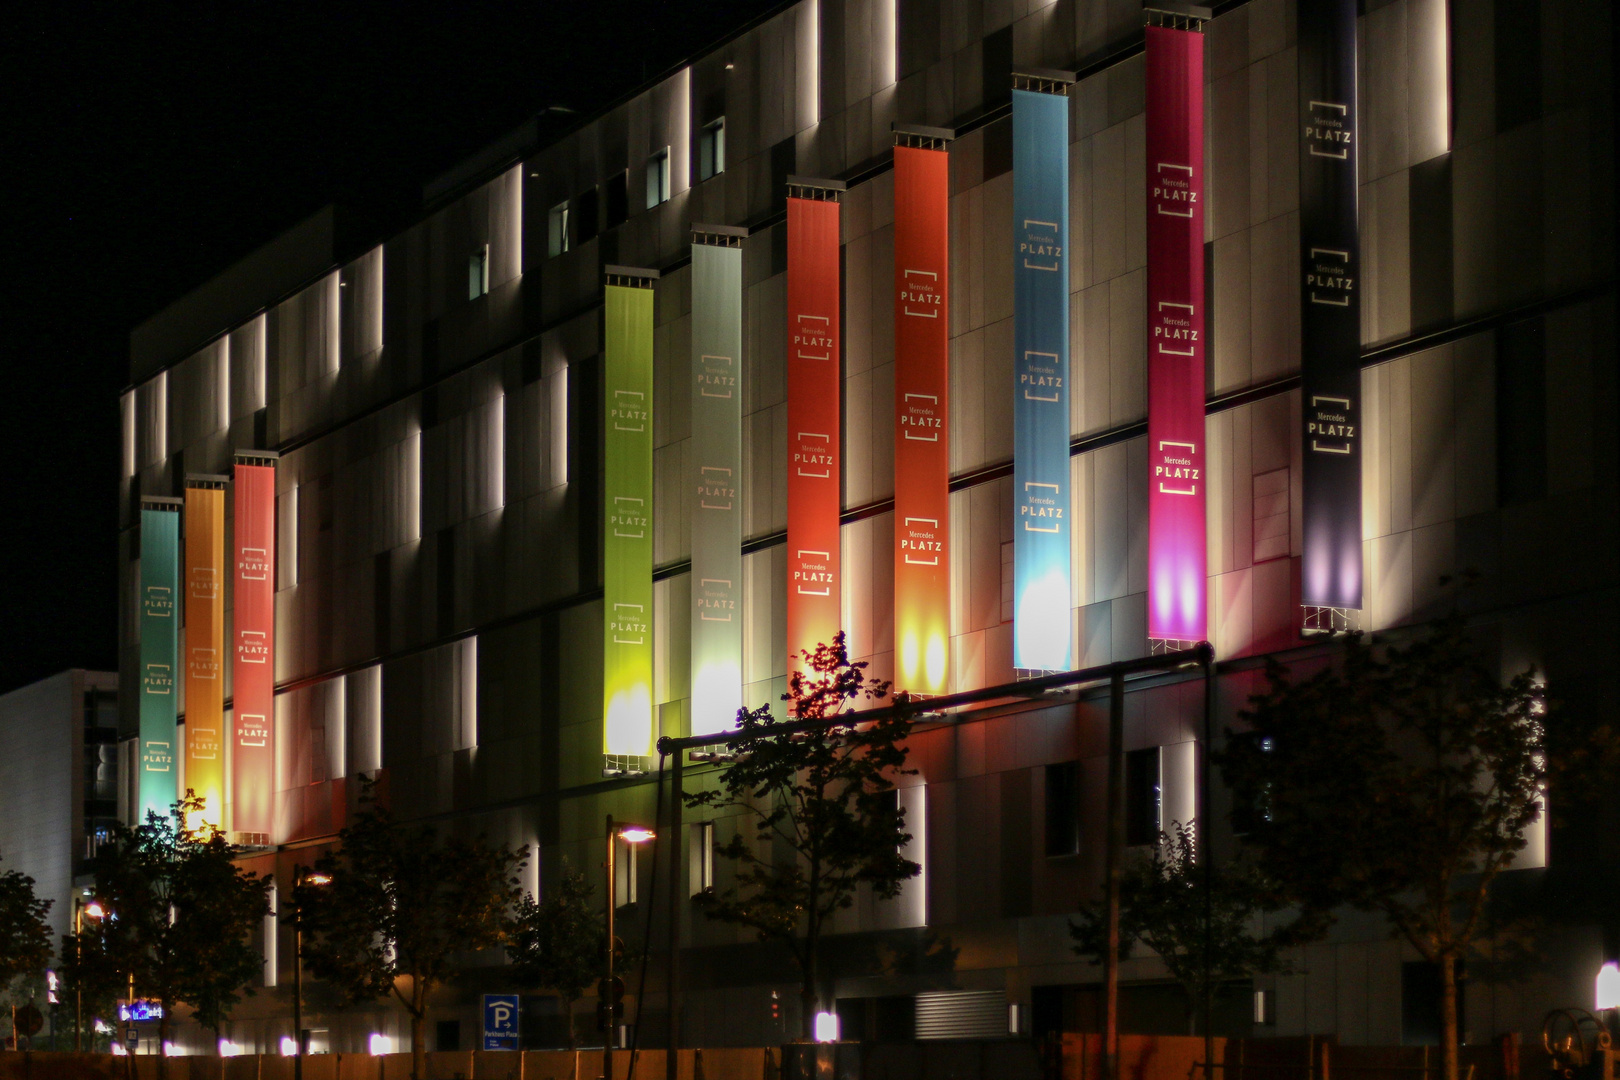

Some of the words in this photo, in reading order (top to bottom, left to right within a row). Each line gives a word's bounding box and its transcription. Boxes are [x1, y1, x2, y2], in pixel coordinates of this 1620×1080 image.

[1314, 116, 1342, 128] Mercedes
[1306, 127, 1351, 143] PLATZ
[1162, 177, 1189, 188] Mercedes
[1154, 187, 1197, 203] PLATZ
[1020, 243, 1061, 257] PLATZ
[1316, 264, 1344, 275] Mercedes
[908, 282, 934, 292] Mercedes
[1307, 274, 1352, 290] PLATZ
[901, 291, 941, 304] PLATZ
[1163, 316, 1190, 327] Mercedes
[801, 326, 826, 336] Mercedes
[1155, 326, 1198, 341] PLATZ
[794, 336, 833, 348] PLATZ
[1028, 365, 1055, 374] Mercedes
[698, 375, 735, 386] PLATZ
[1020, 374, 1062, 388] PLATZ
[611, 409, 647, 420] PLATZ
[909, 406, 934, 415] Mercedes
[901, 415, 941, 428] PLATZ
[1317, 412, 1346, 423] Mercedes
[1309, 422, 1354, 438] PLATZ
[801, 444, 826, 453] Mercedes
[794, 453, 833, 465] PLATZ
[1164, 456, 1191, 466] Mercedes
[1155, 466, 1199, 480] PLATZ
[697, 486, 735, 498] PLATZ
[1029, 496, 1055, 505] Mercedes
[1021, 505, 1063, 519] PLATZ
[611, 516, 647, 526] PLATZ
[909, 530, 934, 540] Mercedes
[901, 539, 942, 552] PLATZ
[239, 563, 268, 571] PLATZ
[801, 562, 826, 571] Mercedes
[794, 571, 833, 583] PLATZ
[190, 582, 219, 590] PLATZ
[145, 600, 173, 608] PLATZ
[698, 599, 735, 610] PLATZ
[610, 622, 647, 633] PLATZ
[239, 646, 268, 654] PLATZ
[190, 662, 219, 670] PLATZ
[144, 678, 172, 686] PLATZ
[238, 729, 268, 737] PLATZ
[190, 742, 218, 750] PLATZ
[144, 755, 172, 763] PLATZ
